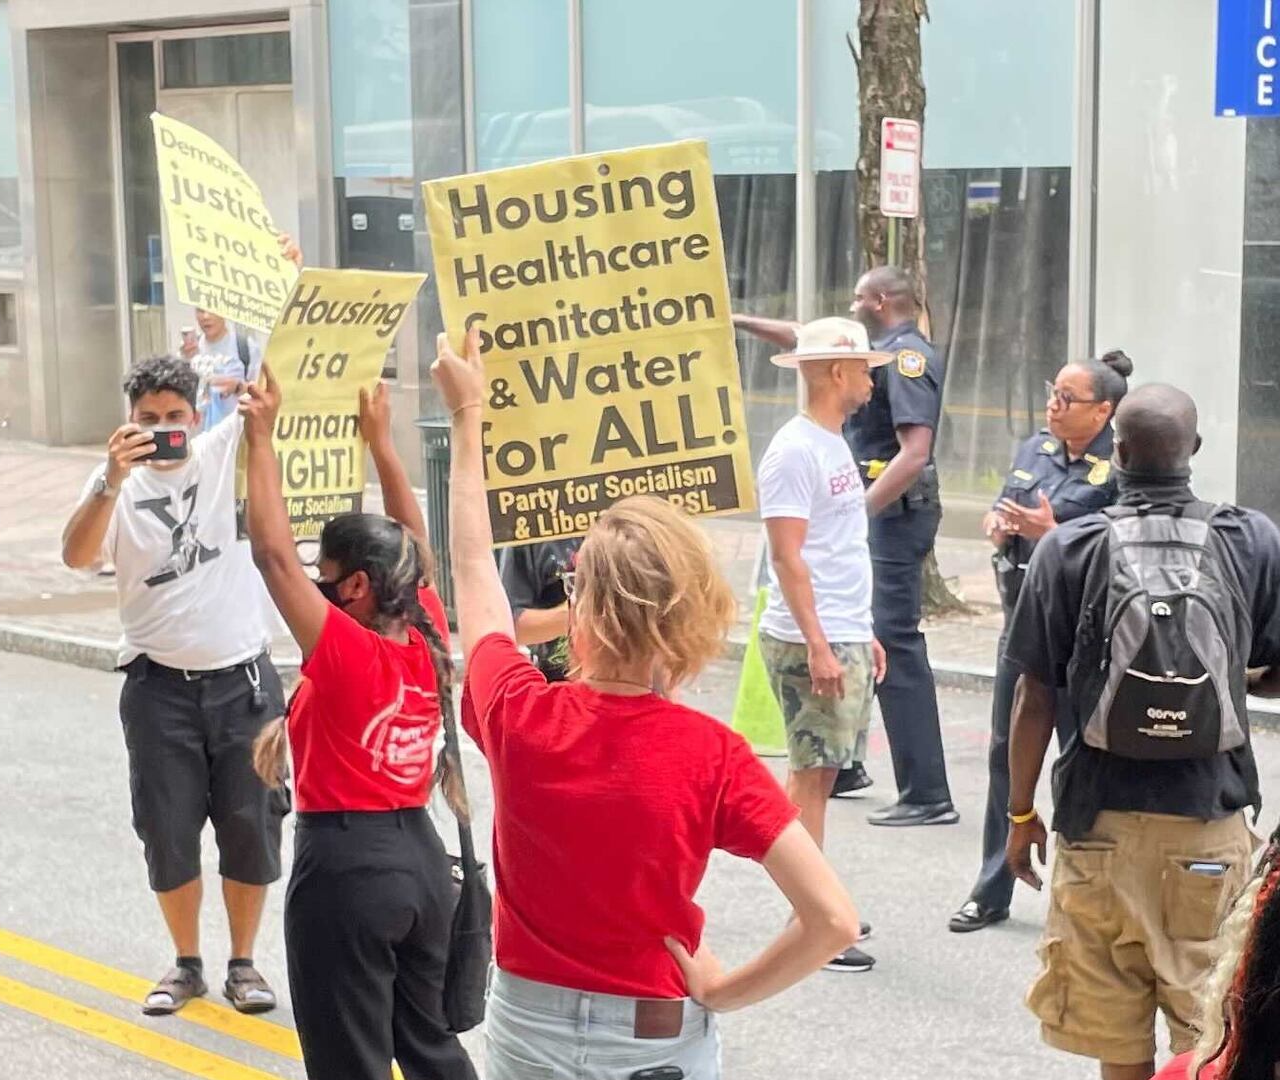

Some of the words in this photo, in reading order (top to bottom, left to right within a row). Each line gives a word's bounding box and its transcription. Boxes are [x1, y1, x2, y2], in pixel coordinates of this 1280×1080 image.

[448, 163, 697, 239] Housing
[185, 213, 208, 243] is
[216, 232, 261, 264] not
[265, 253, 282, 273] a
[454, 233, 710, 298] Healthcare
[185, 251, 290, 303] crime!
[281, 284, 410, 338] Housing
[464, 287, 716, 356] Sanitation
[296, 338, 321, 380] is
[325, 352, 350, 379] a
[489, 378, 519, 411] &
[518, 351, 703, 405] Water
[276, 413, 360, 441] uman
[481, 421, 569, 481] for
[591, 386, 738, 466] ALL!
[277, 447, 355, 490] IGHT!
[498, 488, 559, 516] Party
[565, 480, 599, 505] for
[604, 463, 718, 500] Socialism
[287, 498, 304, 517] for
[304, 496, 353, 516] Socialism
[513, 516, 531, 541] &
[537, 507, 599, 538] Liber
